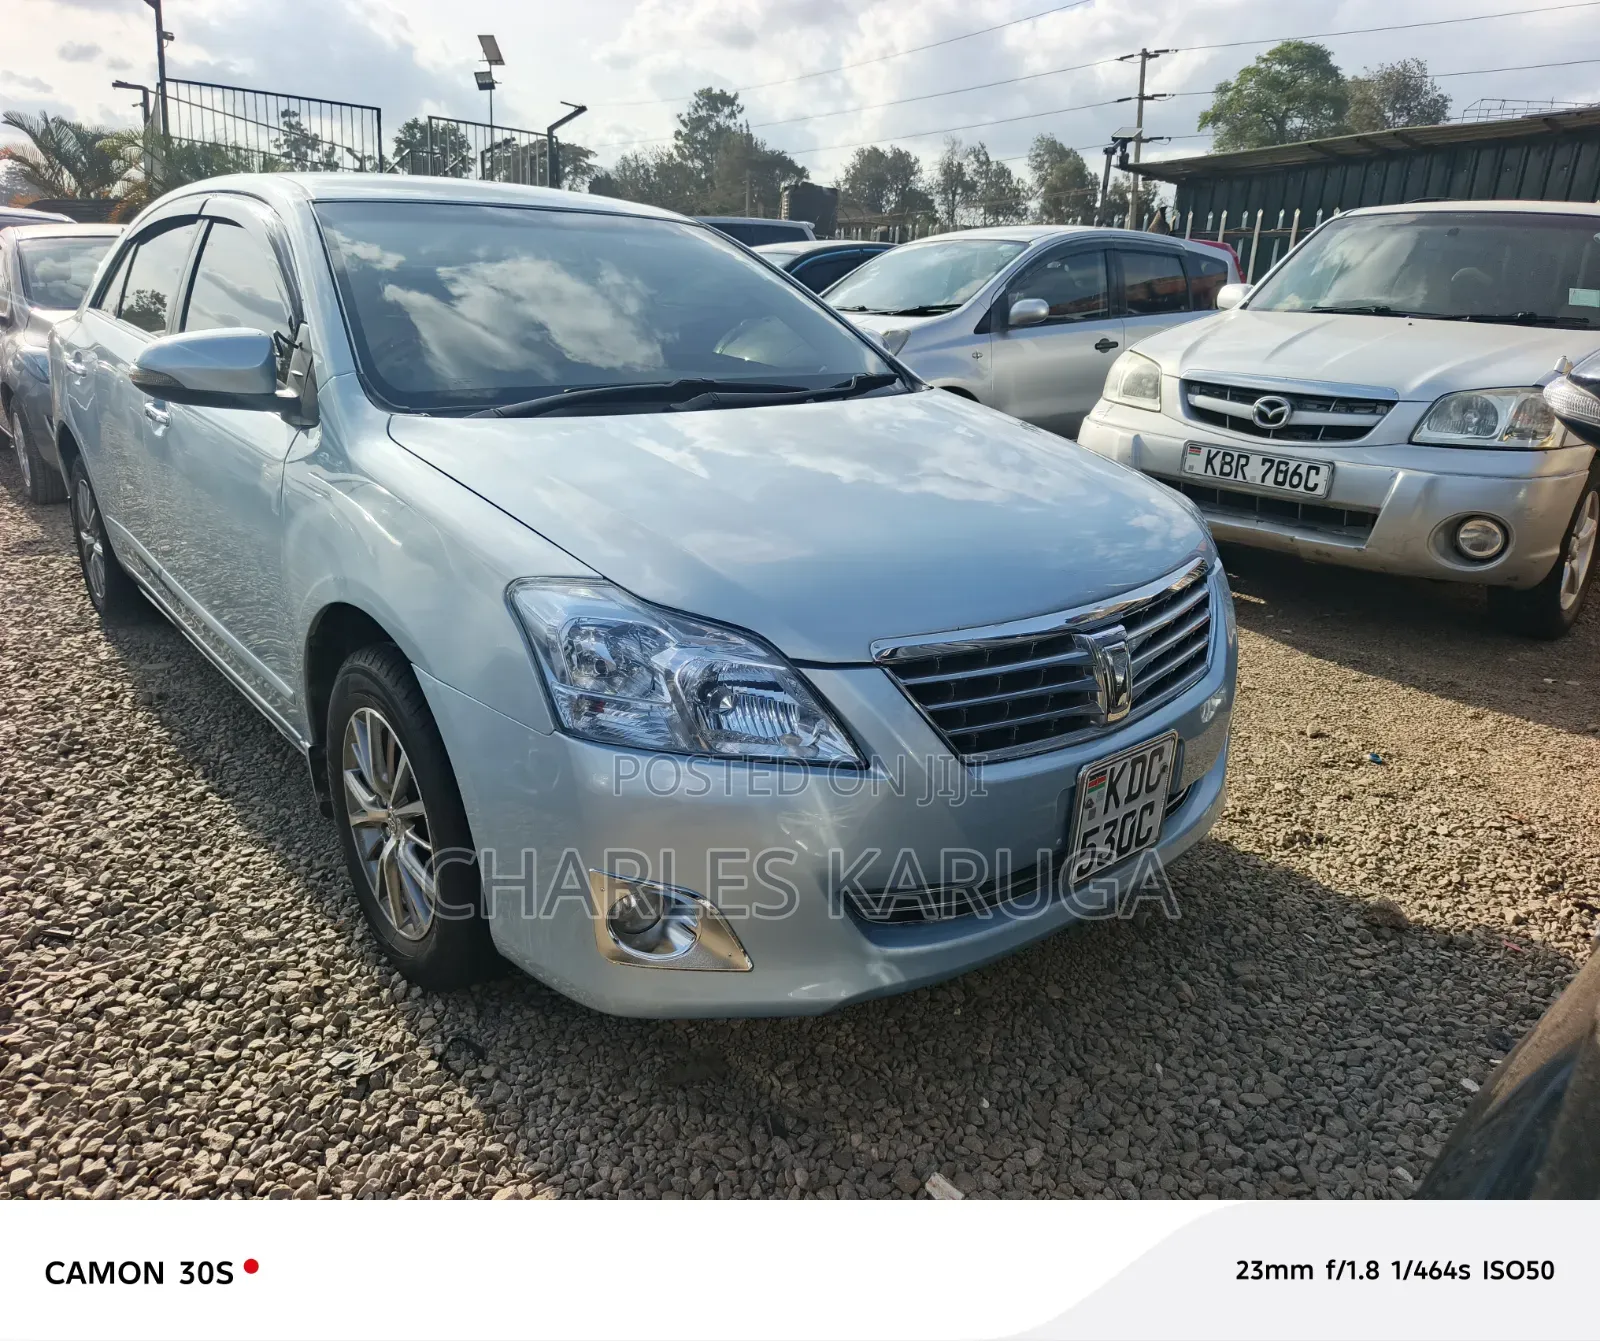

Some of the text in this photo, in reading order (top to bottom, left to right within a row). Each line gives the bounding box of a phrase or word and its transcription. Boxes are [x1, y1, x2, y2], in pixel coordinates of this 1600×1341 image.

[1204, 449, 1250, 480] KBR
[1103, 746, 1165, 815] KDC
[1076, 801, 1155, 877] 530C
